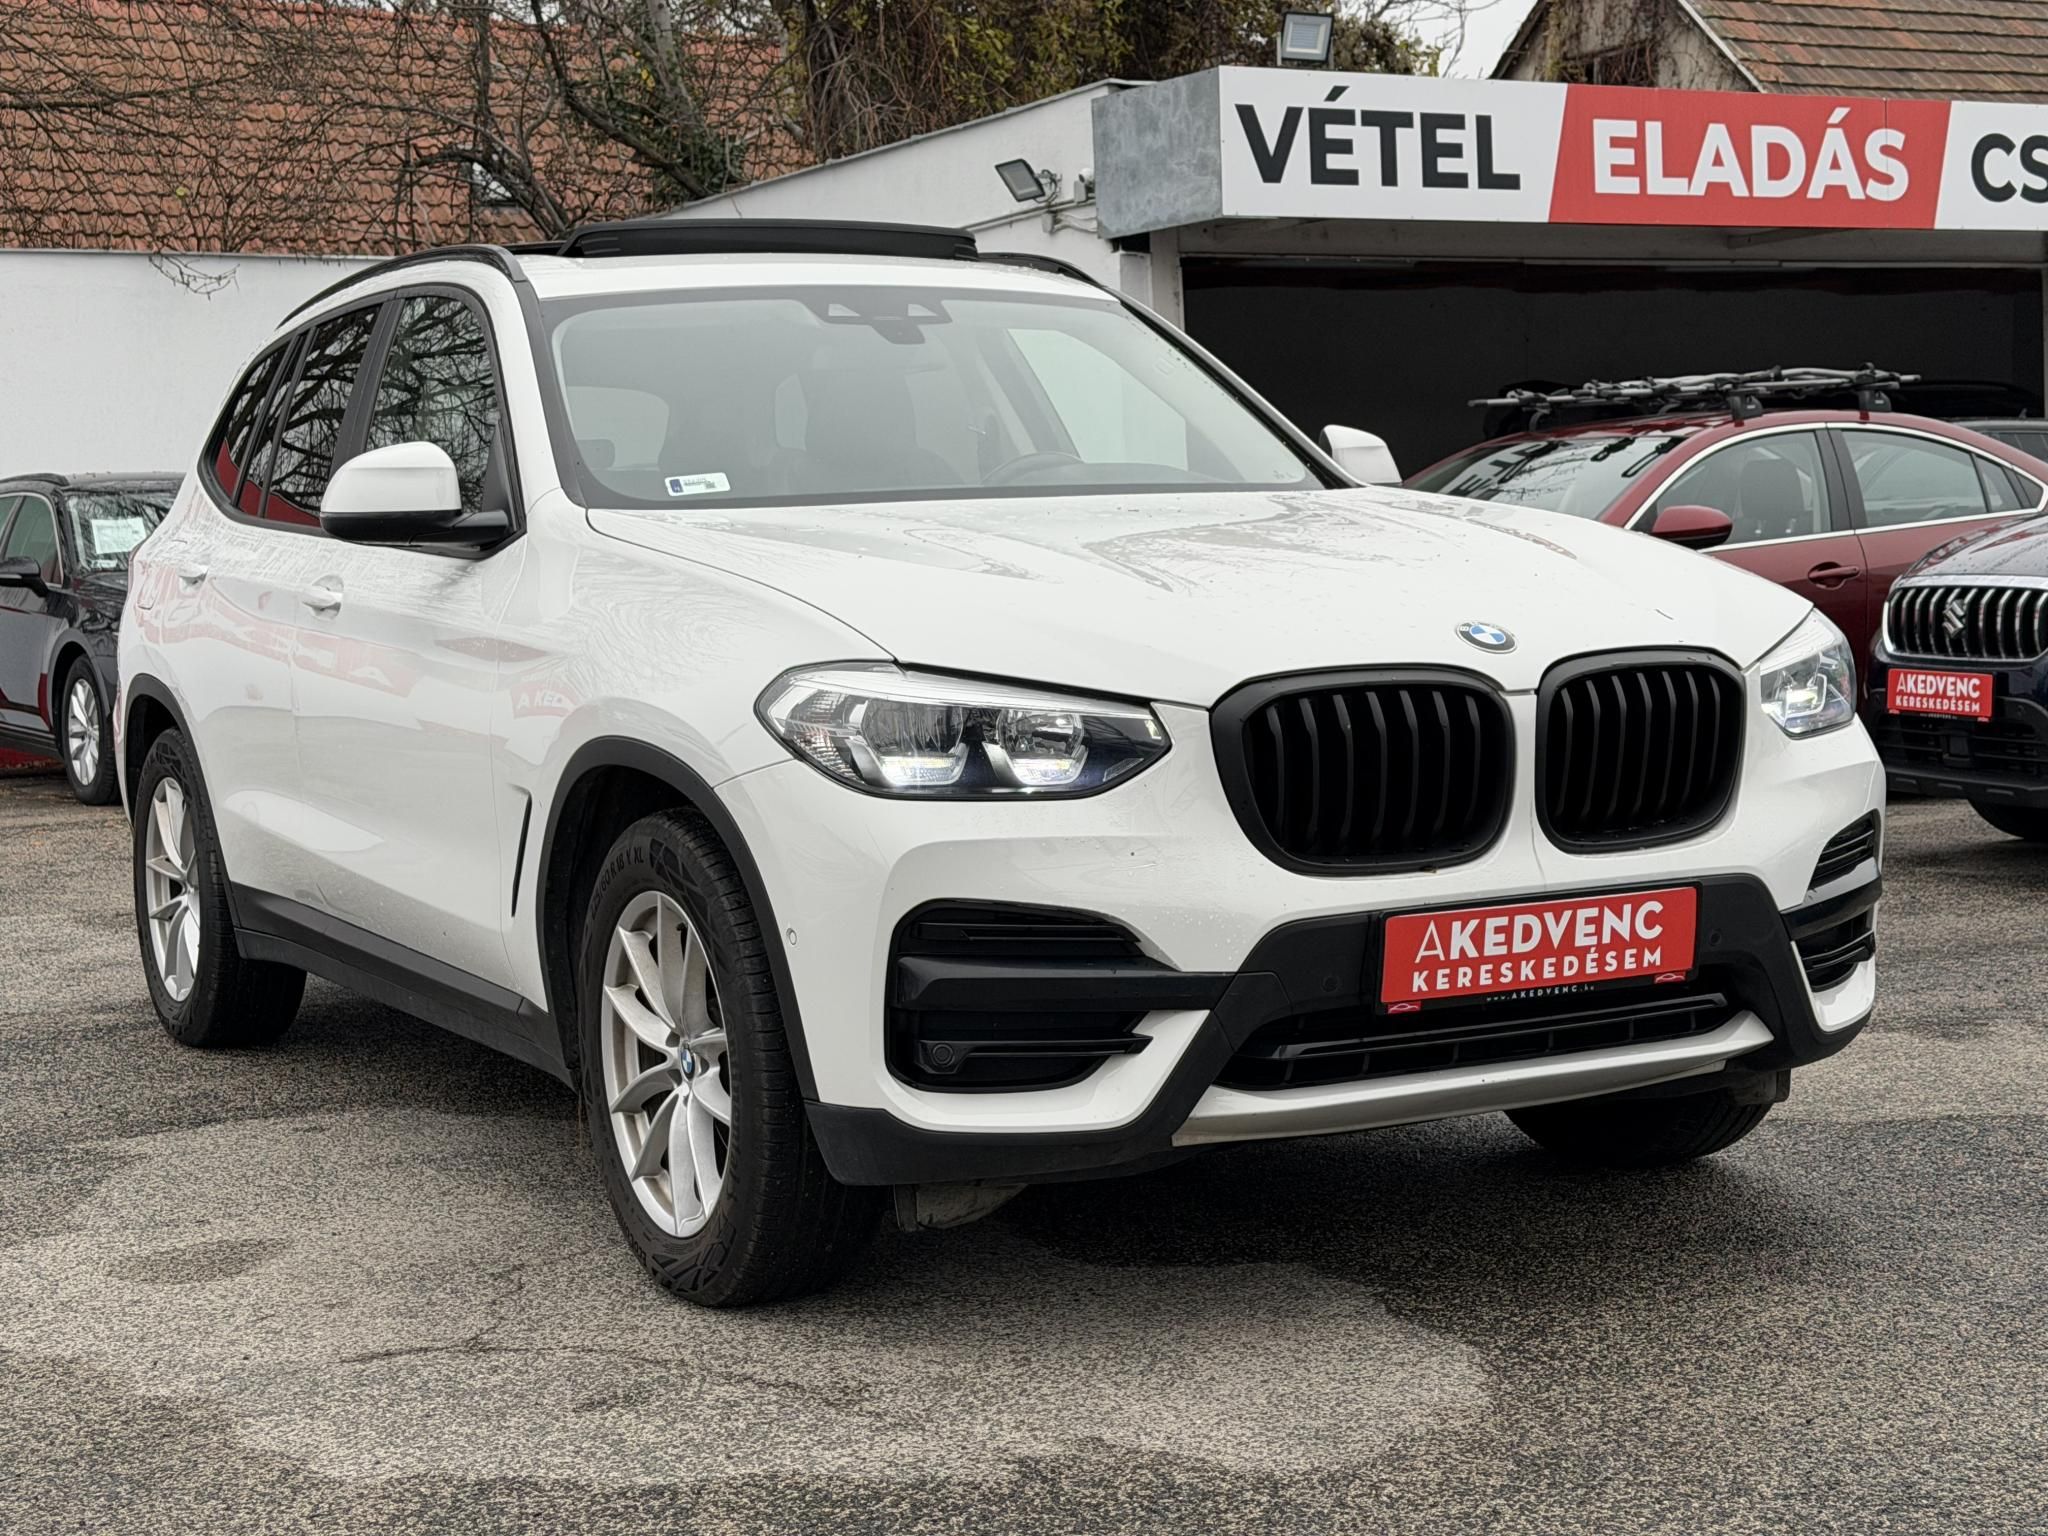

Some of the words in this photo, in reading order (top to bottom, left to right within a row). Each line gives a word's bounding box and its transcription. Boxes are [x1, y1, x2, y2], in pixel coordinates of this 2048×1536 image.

[1235, 85, 1521, 191] VÉTEL
[1593, 107, 1910, 202] ELADÁS
[1971, 133, 2048, 204] CS
[1895, 695, 1981, 713] KERESKEDÉSEM
[1896, 673, 1981, 698] AKEDVENC
[1415, 900, 1664, 963] AKEDVENC
[1412, 947, 1662, 993] KERESKEDÉSEM
